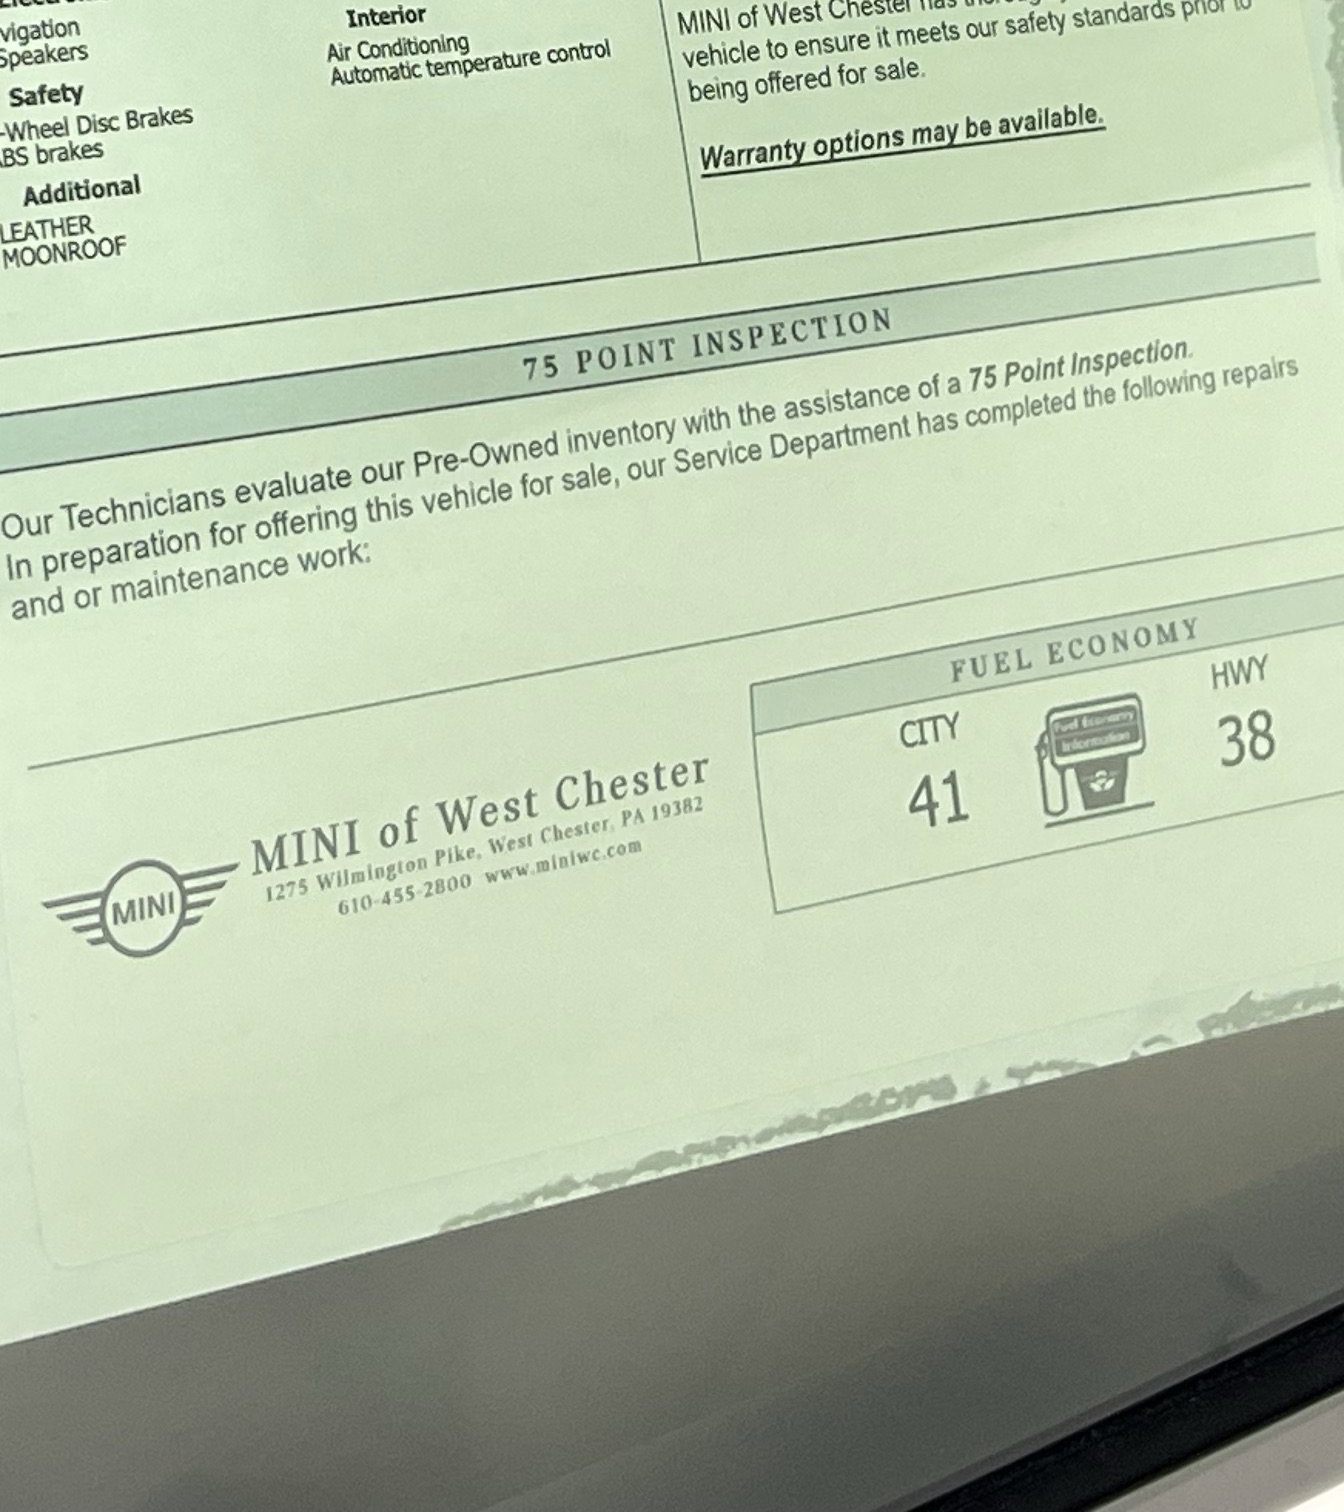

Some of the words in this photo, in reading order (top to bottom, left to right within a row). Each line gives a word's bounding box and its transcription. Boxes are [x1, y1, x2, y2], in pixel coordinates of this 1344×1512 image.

[346, 5, 426, 28] Interior
[678, 8, 730, 35] MINI
[738, 5, 758, 28] of
[763, 0, 823, 26] West
[683, 40, 760, 68] vehicle
[766, 39, 788, 60] to
[795, 34, 870, 56] ensure
[877, 27, 891, 48] it
[896, 21, 960, 46] meets
[966, 20, 998, 39] our
[1005, 11, 1065, 36] safety
[328, 44, 351, 62] Air
[357, 35, 469, 59] Conditioning
[331, 62, 422, 86] Automatic
[426, 51, 541, 77] temperature
[547, 38, 611, 64] control
[9, 83, 83, 107] Safety
[688, 80, 748, 103] being
[755, 65, 831, 94] offered
[837, 63, 867, 86] for
[875, 57, 924, 81] sale.
[77, 115, 120, 135] Disc
[126, 107, 193, 130] Brakes
[700, 138, 806, 174] Warranty
[813, 126, 905, 161] options
[911, 120, 960, 147] may
[964, 114, 993, 138] be
[997, 102, 1105, 134] available.
[36, 141, 104, 164] brakes
[24, 174, 140, 206] Additional
[0, 215, 94, 244] LEATHER
[3, 235, 126, 269] MOONROOF
[523, 355, 558, 380] 75
[576, 338, 675, 374] POINT
[693, 308, 890, 357] INSPECTION
[1, 513, 53, 539] Our
[60, 489, 226, 530] Technicians
[235, 467, 352, 503] evaluate
[362, 461, 405, 484] our
[414, 431, 558, 477] Pre-Owned
[567, 419, 675, 453] inventory
[683, 406, 731, 435] with
[738, 402, 776, 426] the
[785, 385, 910, 419] assistance
[918, 373, 939, 399] of
[948, 377, 961, 394] a
[970, 365, 996, 391] 75
[1005, 356, 1064, 387] Point
[1071, 339, 1194, 376] Inspection.
[7, 554, 32, 580] In
[42, 530, 200, 581] preparation
[209, 521, 246, 547] for
[255, 506, 357, 539] offering
[366, 493, 413, 522] this
[422, 478, 512, 513] vehicle
[520, 473, 553, 498] for
[562, 463, 619, 491] sale,
[628, 458, 666, 480] our
[674, 441, 761, 473] Service
[770, 415, 911, 459] Department
[917, 412, 958, 435] has
[966, 387, 1076, 427] completed
[1083, 384, 1116, 407] the
[1123, 372, 1216, 401] following
[1223, 356, 1298, 388] repairs
[12, 586, 64, 620] and
[74, 587, 102, 609] or
[112, 557, 288, 603] maintenance
[297, 540, 370, 572] work:
[950, 648, 1032, 683] FUEL
[1047, 617, 1197, 665] ECONOMY
[1212, 654, 1268, 689] HWY
[900, 711, 959, 748] CITY
[1219, 710, 1275, 766] 38
[252, 820, 362, 876] MINI
[380, 805, 419, 848] of
[435, 788, 538, 835] West
[556, 759, 708, 810] Chester
[909, 770, 969, 827] 41
[267, 879, 308, 902] 1275
[316, 858, 427, 891] Wilmington
[488, 834, 532, 854] West
[622, 808, 644, 827] PA
[652, 797, 702, 820] 19382
[339, 874, 471, 915] 610-455-2800
[485, 841, 641, 883] www.miniwc.com
[111, 892, 176, 926] MINI
